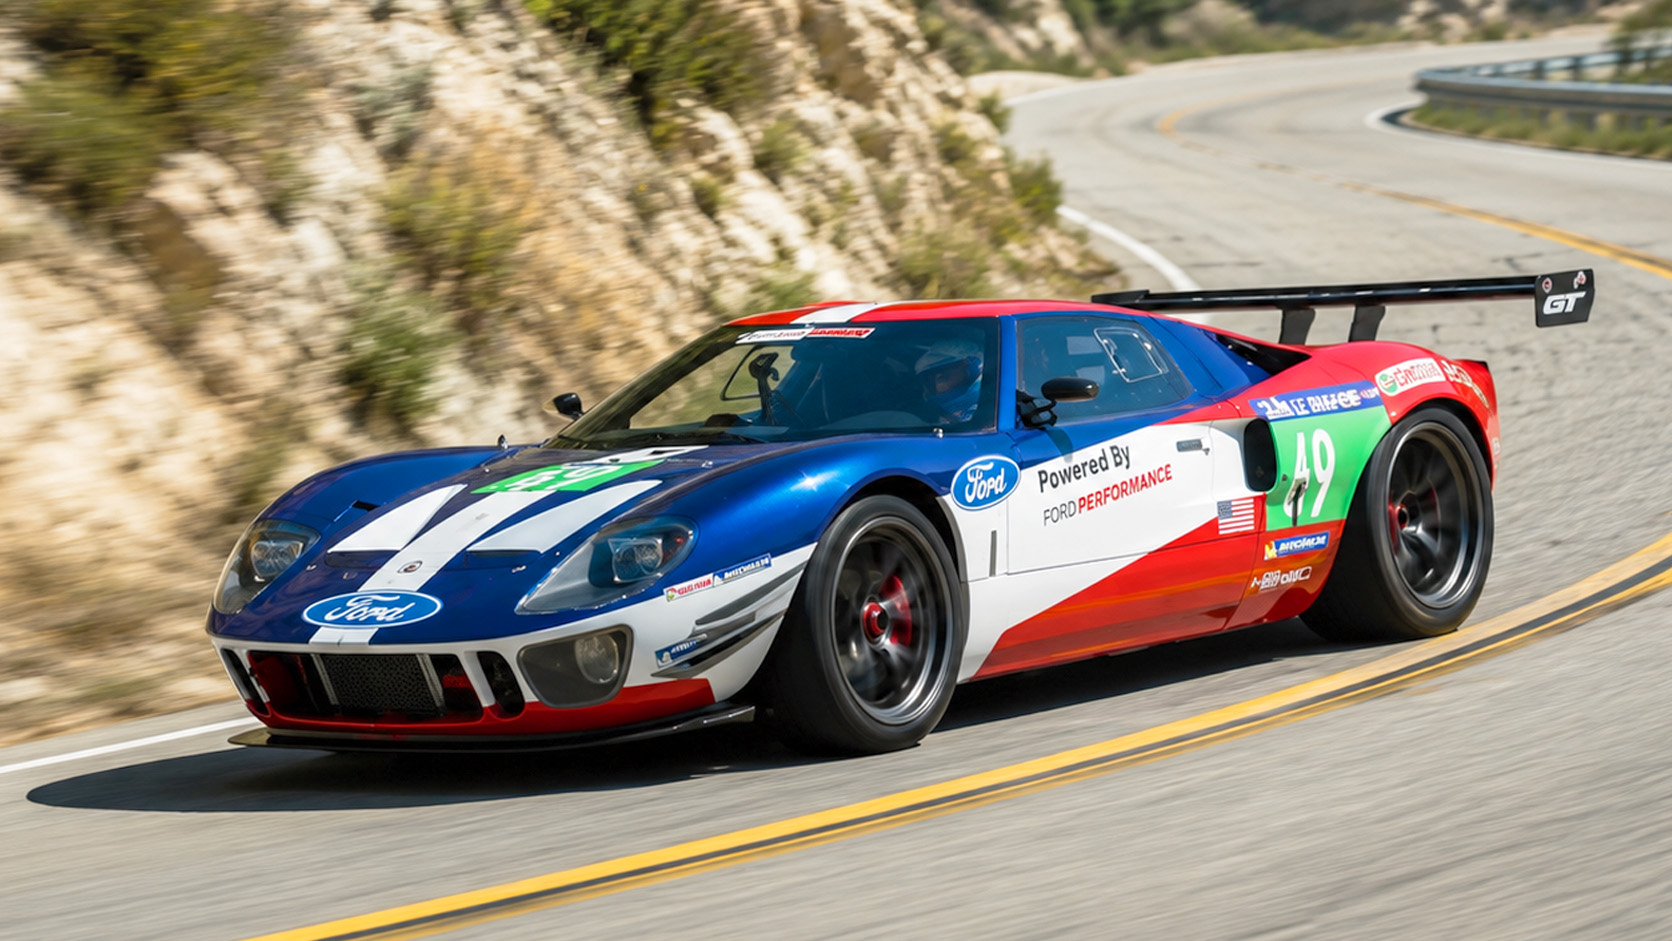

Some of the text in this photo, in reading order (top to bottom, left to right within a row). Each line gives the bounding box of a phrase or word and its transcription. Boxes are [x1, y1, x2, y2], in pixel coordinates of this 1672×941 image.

[1543, 291, 1587, 315] GT
[965, 461, 1007, 503] Ford
[1038, 444, 1131, 493] Powered By
[1283, 428, 1336, 519] 49
[1043, 463, 1173, 526] FORD PERFORMANCE
[324, 595, 406, 621] Ford
